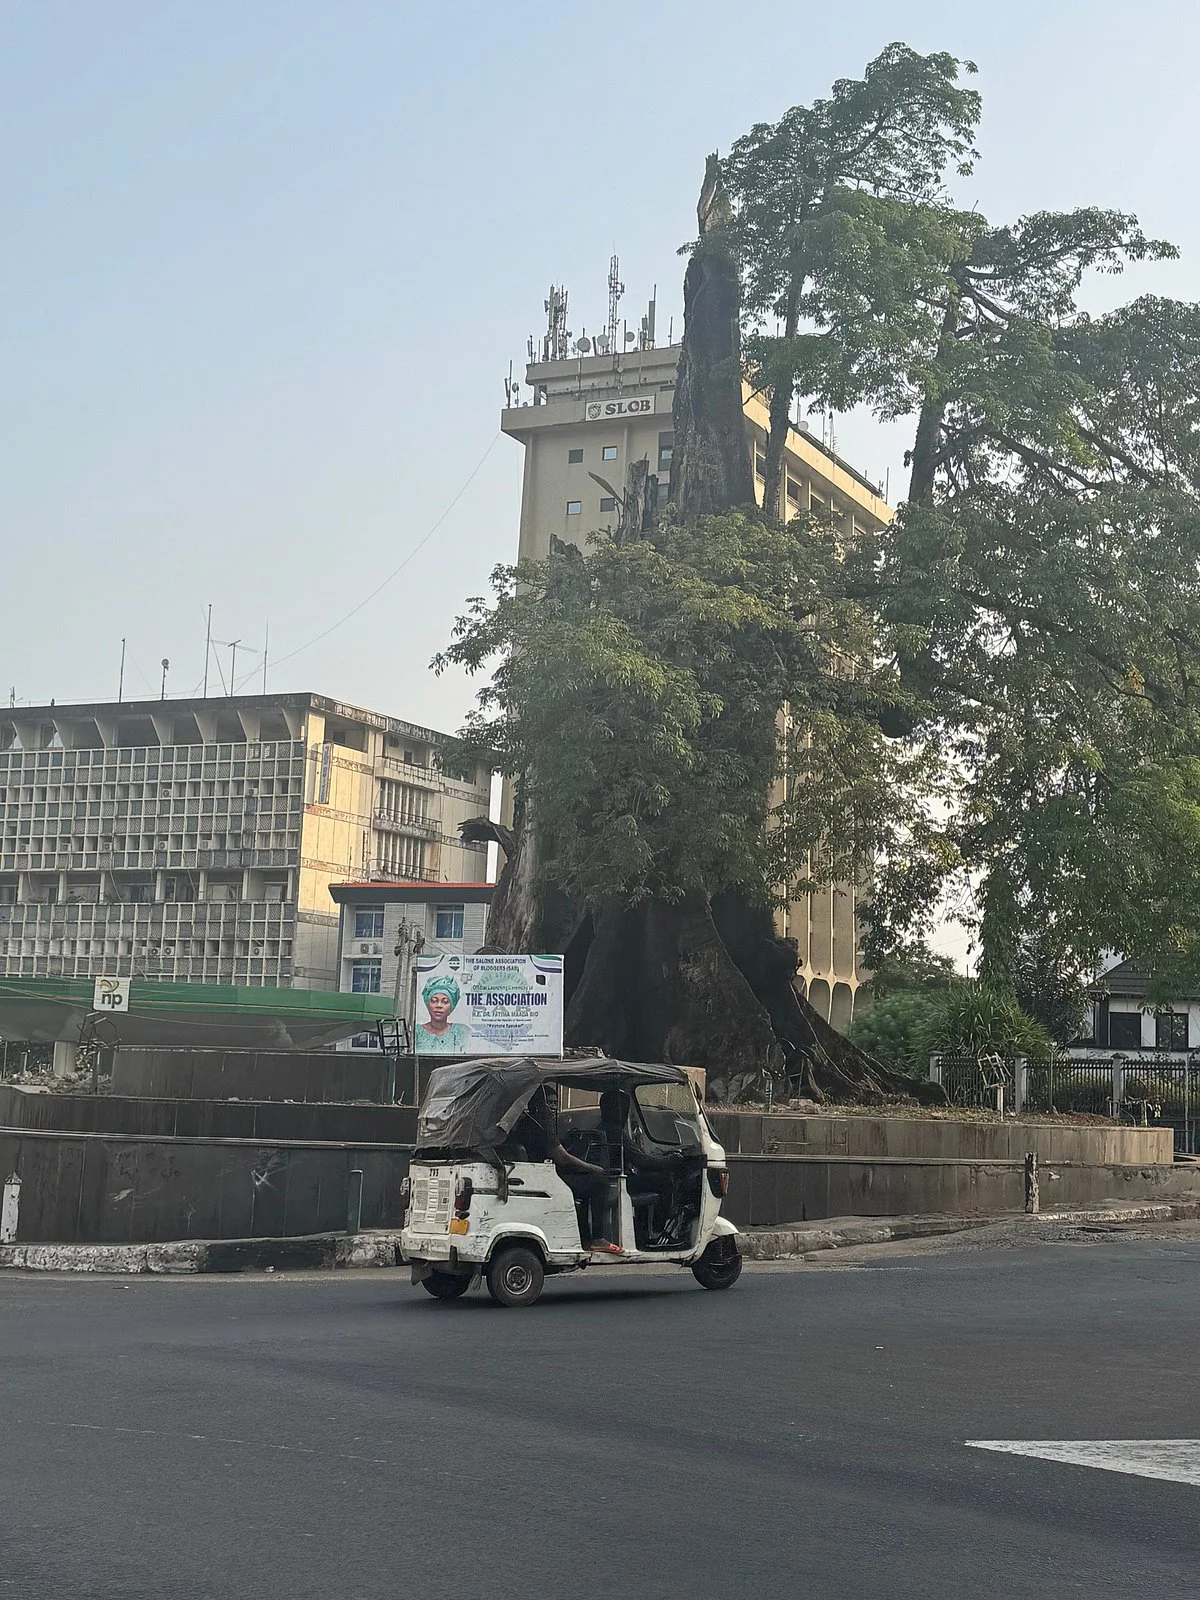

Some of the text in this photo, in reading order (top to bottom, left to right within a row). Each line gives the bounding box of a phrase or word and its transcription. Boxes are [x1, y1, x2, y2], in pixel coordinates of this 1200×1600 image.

[101, 993, 123, 1009] np
[465, 993, 547, 1005] THE ASSOCIATION
